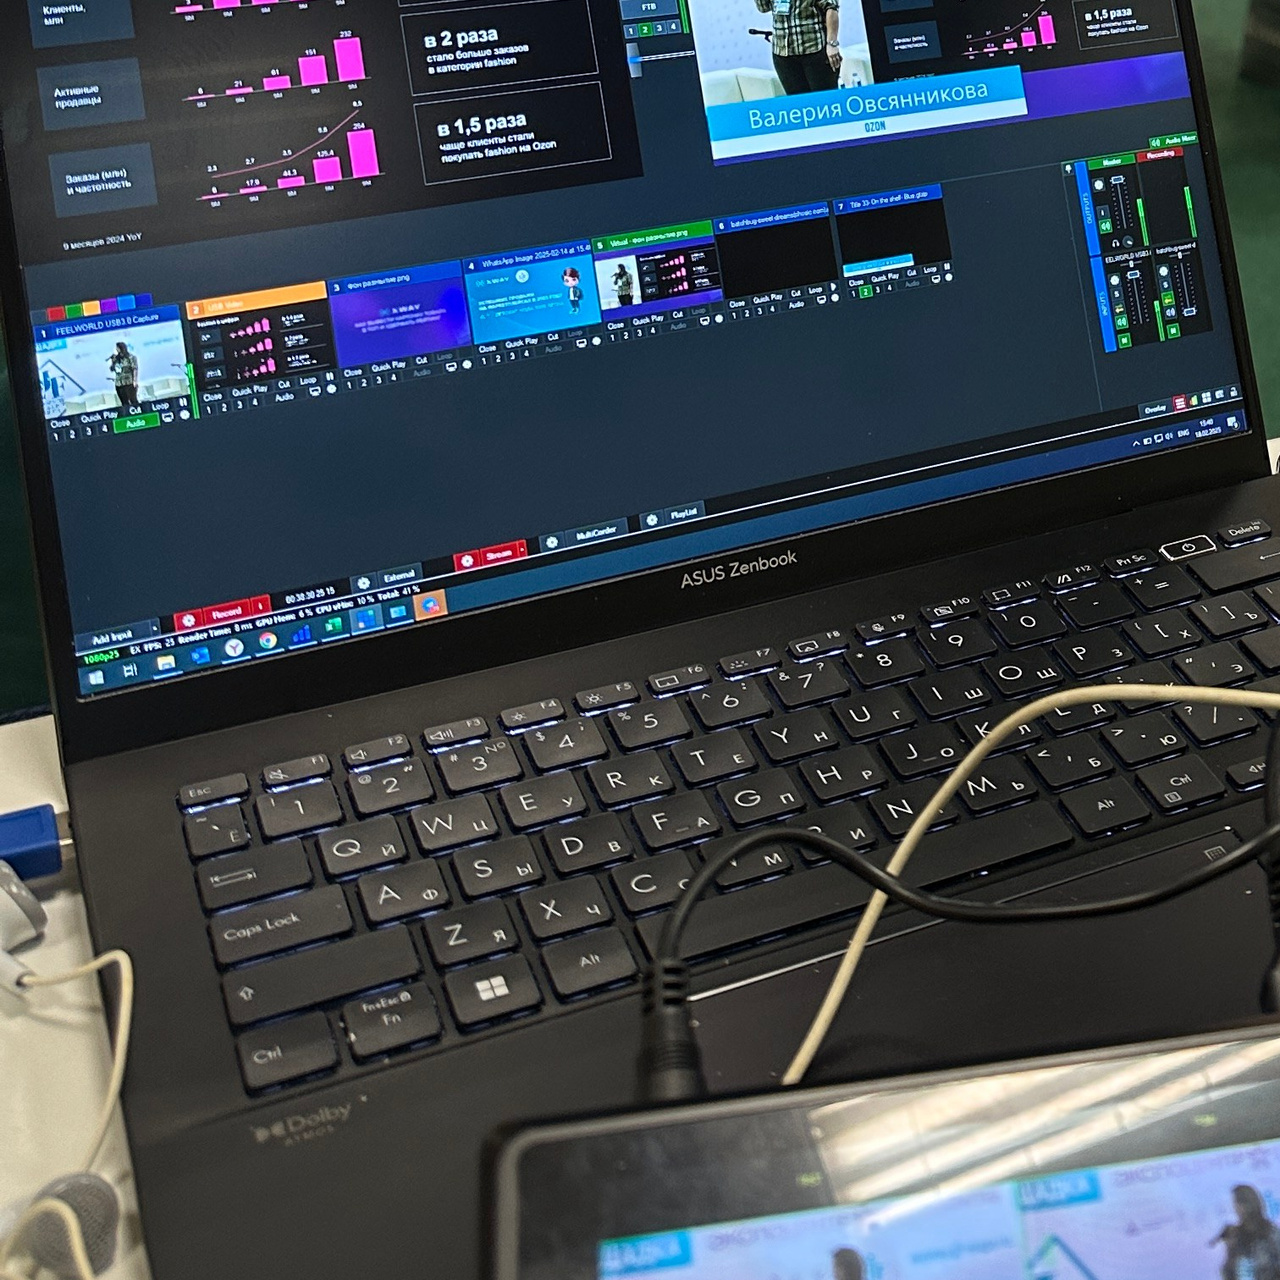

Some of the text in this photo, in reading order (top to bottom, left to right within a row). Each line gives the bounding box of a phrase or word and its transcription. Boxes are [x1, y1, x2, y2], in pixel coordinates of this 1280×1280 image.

[43, 4, 86, 15] Клиенты,
[642, 2, 656, 12] FTB
[424, 28, 498, 49] в 2 раза
[426, 44, 529, 63] стало больше заказов
[436, 62, 483, 74] категории
[484, 56, 517, 68] fashion
[54, 84, 99, 98] Активные
[56, 96, 102, 110] продавцы
[748, 80, 989, 130] Валерия Овсянникова
[437, 114, 527, 137] в 1,5 раза
[864, 120, 886, 133] OZON
[440, 132, 534, 152] чаще клиенты стали
[441, 140, 557, 164] покупать fashion на Ozon
[65, 172, 98, 185] Заказы
[66, 180, 132, 196] и частотность
[1083, 192, 1093, 224] OUTPUTS
[70, 238, 105, 250] месяцев
[106, 235, 126, 246] 2024
[126, 232, 143, 242] YoY
[56, 322, 104, 336] FEELWORLD
[133, 314, 160, 324] Capture
[670, 507, 698, 520] PlayList
[1228, 524, 1260, 537] Delete
[1132, 554, 1147, 563] Sc
[384, 569, 416, 583] External
[680, 550, 798, 589] ASUS Zenbook
[1075, 564, 1092, 573] F12
[951, 597, 970, 607] F10
[212, 606, 242, 620] Record
[92, 630, 132, 645] Add Input
[948, 634, 964, 647] 9
[84, 650, 120, 665] 1080p25
[876, 654, 893, 668] 8
[1072, 646, 1087, 660] P
[798, 673, 813, 688] 7
[723, 694, 740, 708] 6
[644, 713, 658, 729] 5
[849, 706, 871, 723] U
[558, 734, 576, 749] 4
[771, 728, 789, 744] Y
[472, 756, 488, 772] 3
[690, 750, 706, 766] T
[606, 772, 626, 789] R
[816, 766, 842, 785] H
[1170, 773, 1193, 787] Ctrl
[188, 786, 212, 798] Esc
[966, 776, 998, 796] M
[519, 793, 538, 812] E
[734, 790, 762, 807] G
[1098, 798, 1116, 812] Alt
[422, 814, 454, 836] W
[652, 812, 668, 831] F
[332, 838, 362, 858] Q
[560, 837, 584, 856] D
[473, 860, 494, 878] S
[630, 874, 658, 893] C
[378, 884, 402, 906] A
[222, 912, 301, 942] Caps Lock
[444, 924, 468, 946] Z
[580, 954, 602, 968] Alt
[382, 1013, 402, 1026] Fn
[253, 1045, 282, 1065] Ctrl
[286, 1104, 351, 1132] Dolby
